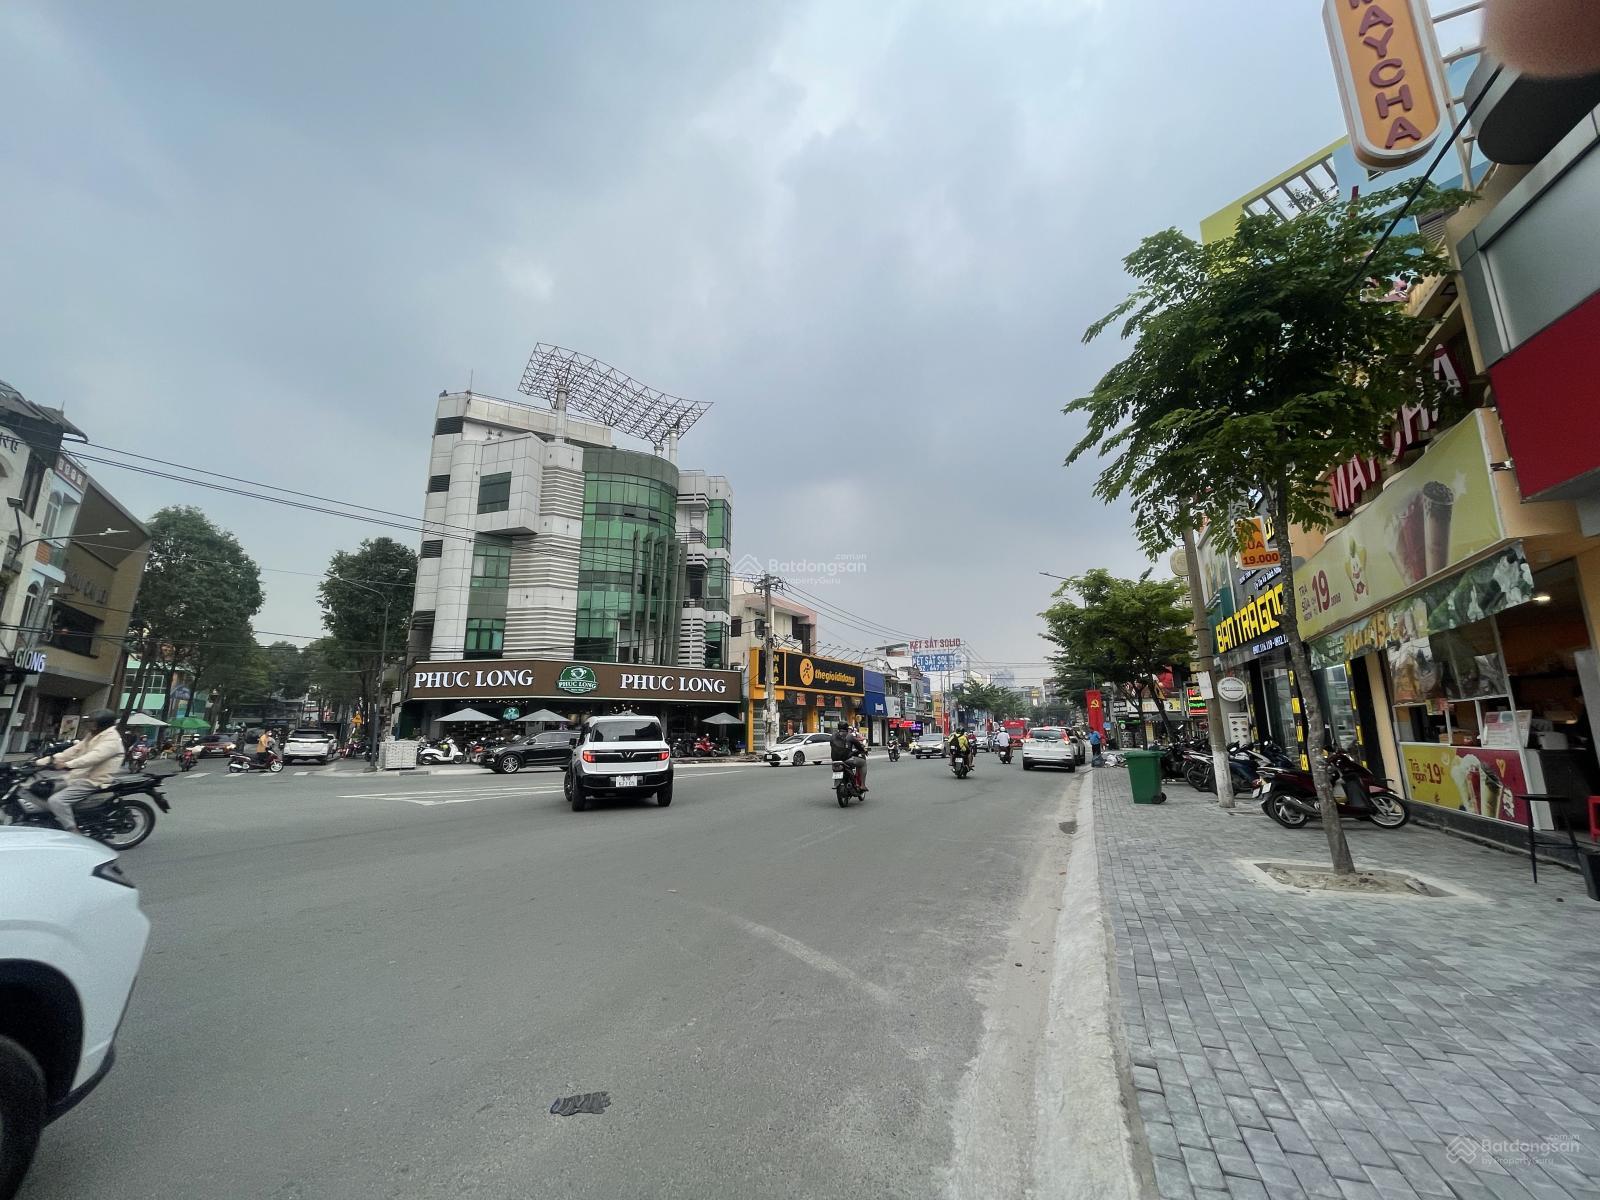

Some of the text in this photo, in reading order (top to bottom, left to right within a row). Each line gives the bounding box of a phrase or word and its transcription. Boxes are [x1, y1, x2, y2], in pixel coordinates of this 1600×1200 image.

[1348, 0, 1423, 150] AYCHA
[1243, 552, 1279, 566] 19.000
[1311, 569, 1331, 614] 19
[413, 669, 534, 689] PHUC LONG
[619, 673, 727, 694] PHUC LONG
